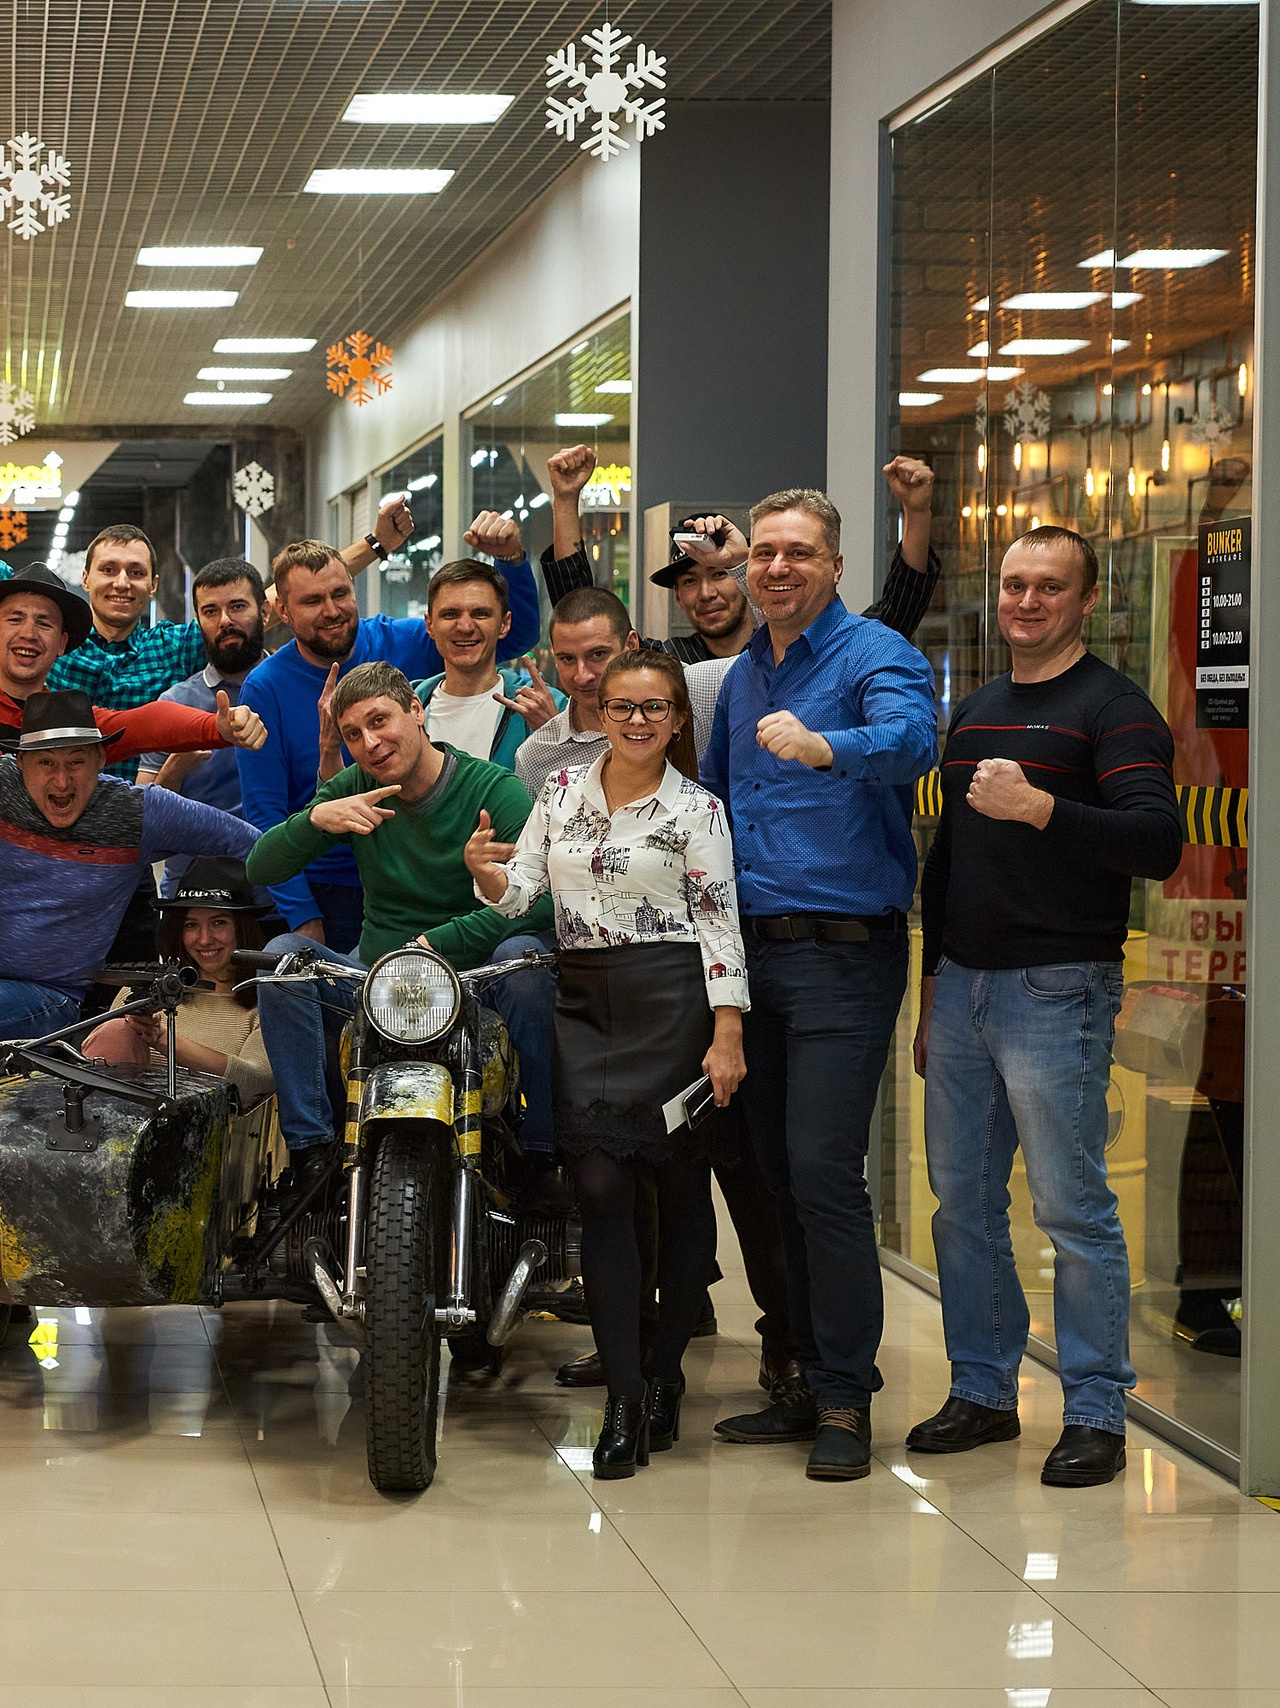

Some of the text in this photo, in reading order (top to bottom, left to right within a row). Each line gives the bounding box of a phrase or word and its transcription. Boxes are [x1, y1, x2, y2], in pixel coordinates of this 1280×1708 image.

[1207, 528, 1242, 556] BUNKER
[1213, 592, 1242, 608] 10.00-21.00
[1212, 630, 1242, 645] 10.00-22.00
